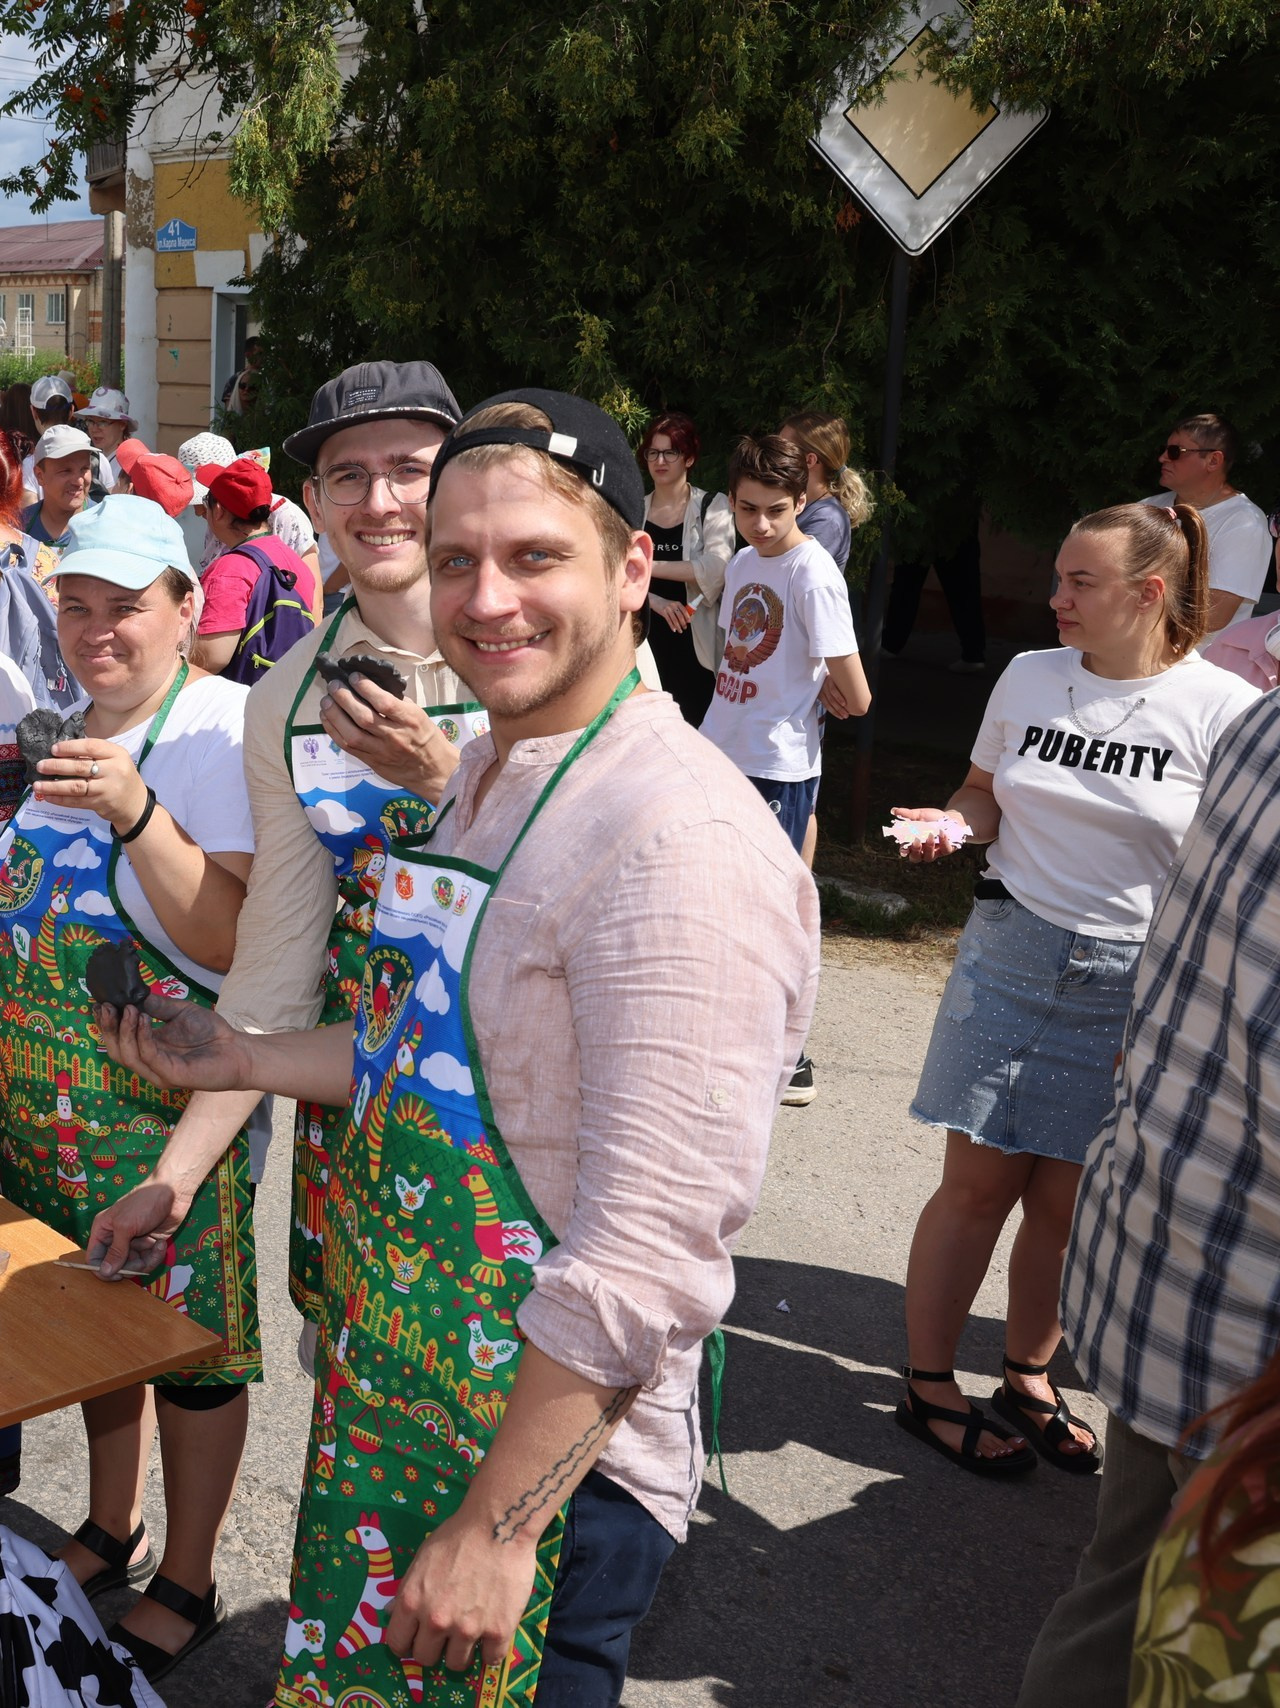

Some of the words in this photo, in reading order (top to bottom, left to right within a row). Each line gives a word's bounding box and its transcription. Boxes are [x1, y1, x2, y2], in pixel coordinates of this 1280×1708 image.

[168, 221, 180, 237] 41
[716, 672, 758, 704] СССР
[1018, 725, 1173, 782] PUBERTY
[383, 799, 428, 816] СКАЗКИ
[369, 949, 413, 978] СКАЗКИ
